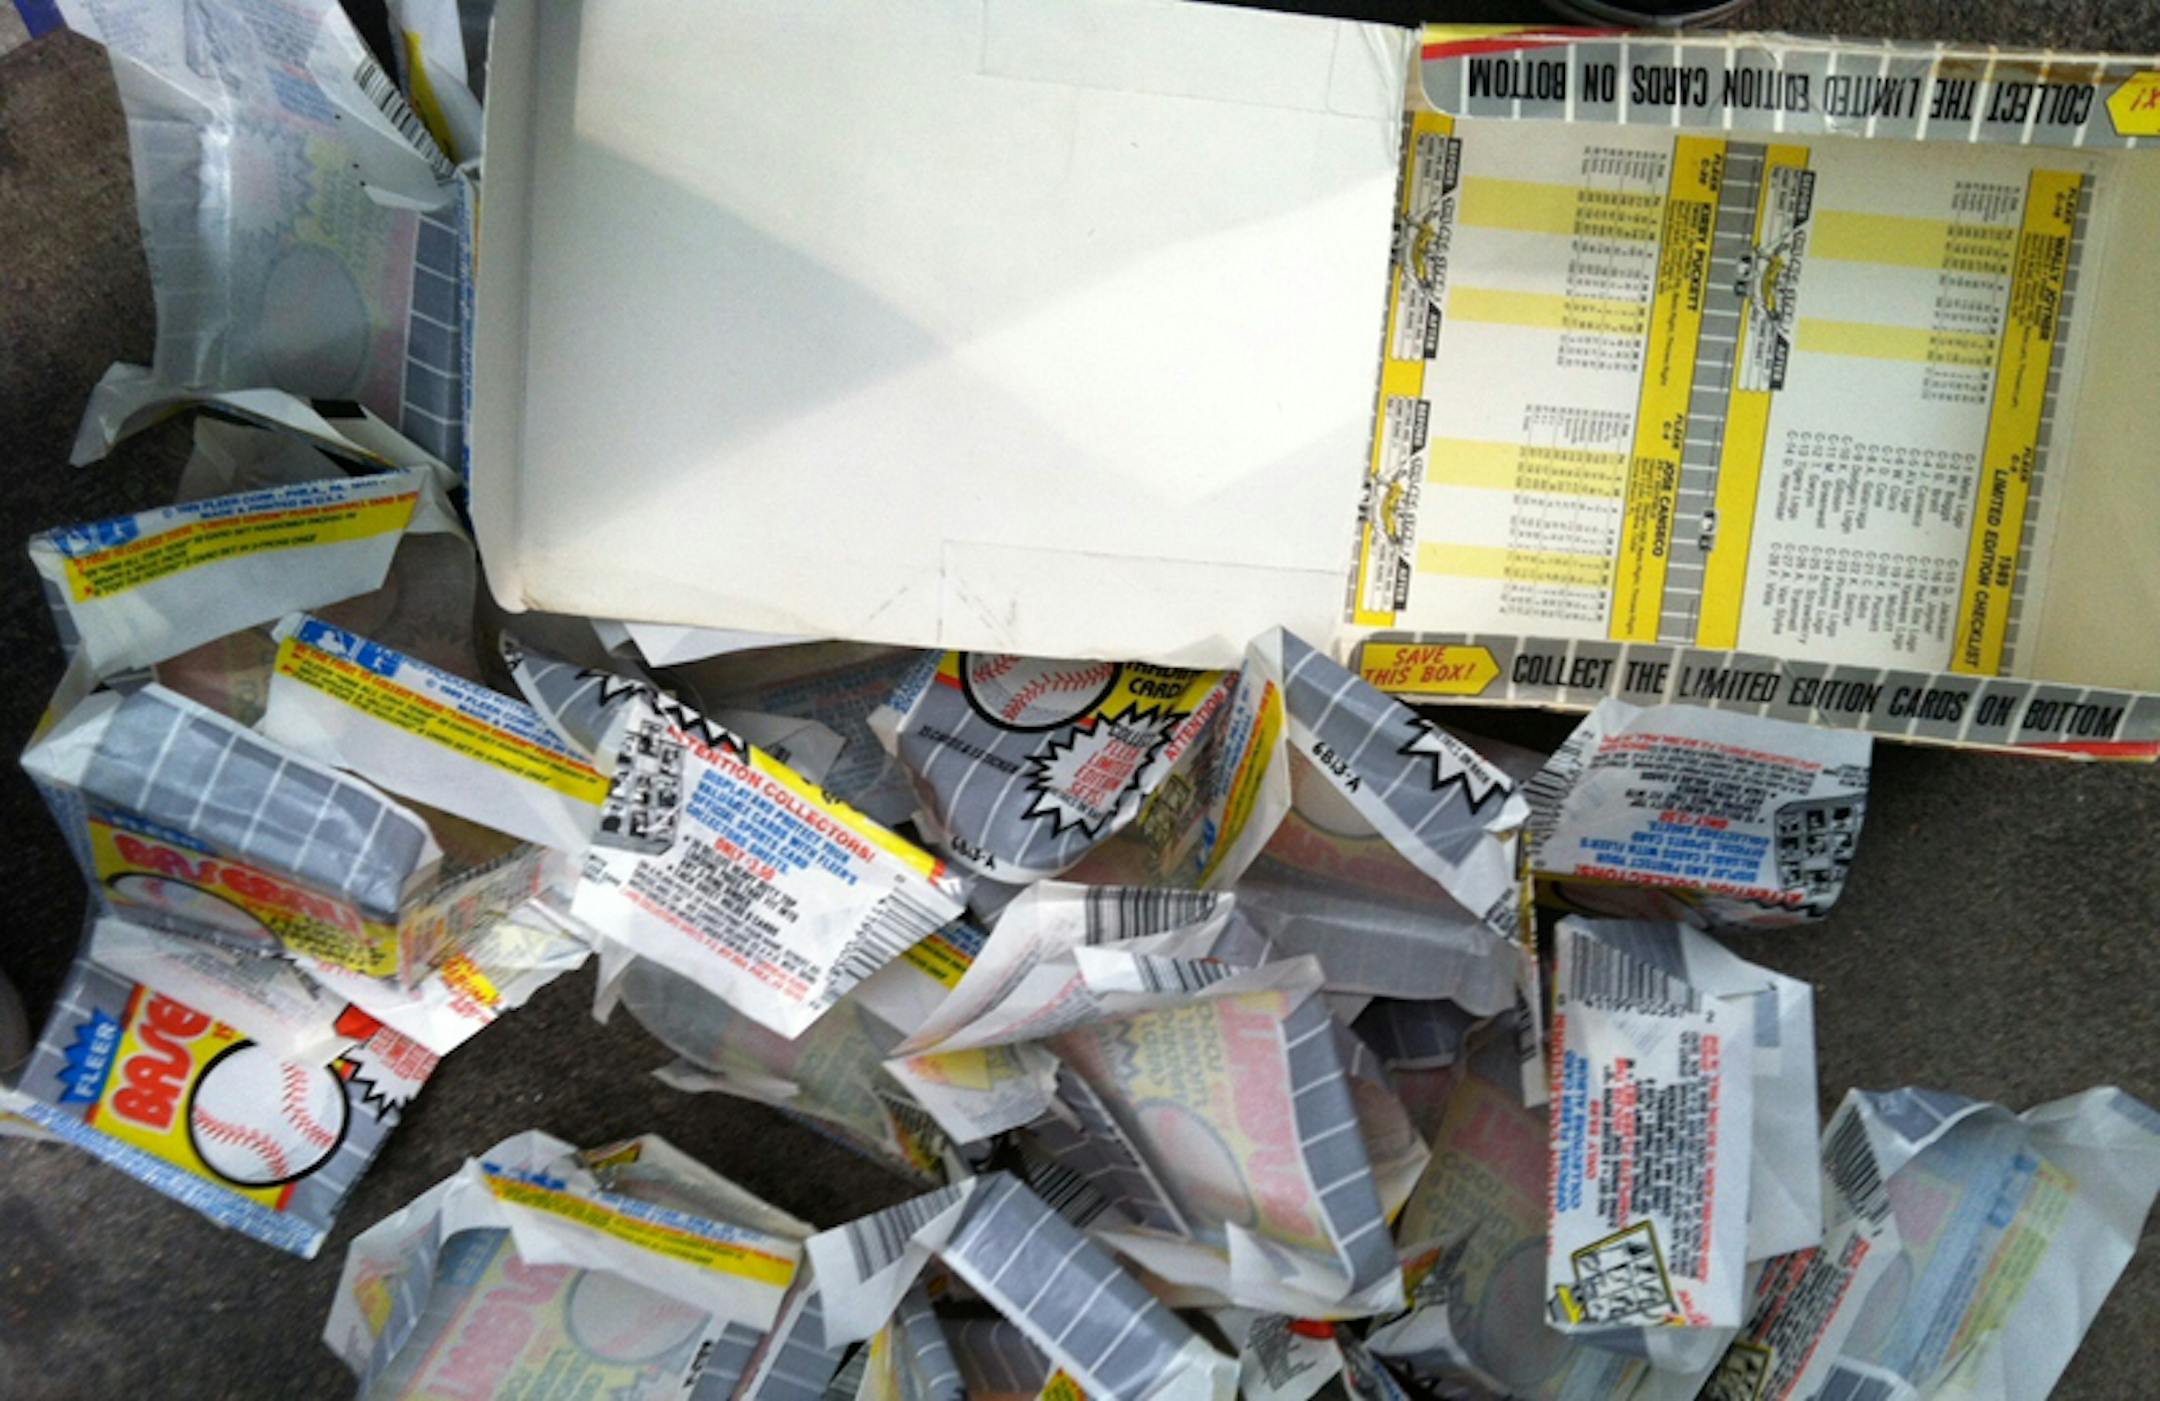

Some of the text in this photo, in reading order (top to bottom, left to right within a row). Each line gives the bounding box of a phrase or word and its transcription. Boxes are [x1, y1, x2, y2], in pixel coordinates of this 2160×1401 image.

[1466, 56, 2094, 126] COLLECT THE LIMITED EDITION CARDS ON BOTTOM
[1685, 202, 1711, 313] KIRBY PUCKETT
[2038, 235, 2066, 342] WALLY JOYNER
[1786, 459, 1806, 520] Tigers Logo
[1802, 473, 1819, 508] Gwynn
[1815, 480, 1832, 530] Greenwell
[1831, 477, 1846, 513] Gibson
[1839, 463, 1862, 534] Dodgers Logo
[1873, 481, 1887, 508] Cone
[1898, 487, 1913, 514] Logo
[1911, 484, 1927, 527] Canseco
[1651, 459, 1675, 558] JOSE CANSECO
[1951, 503, 1966, 529] Logo
[1962, 467, 2008, 668] LIMITED EDITION CHECKLIST
[1994, 555, 2011, 588] 1989
[1762, 581, 1775, 606] Viola
[1776, 584, 1788, 605] Van
[1817, 573, 1831, 608] Astros
[1830, 575, 1845, 610] Pirates
[1856, 593, 1869, 619] Sabo
[1896, 582, 1911, 624] Yankees
[1913, 584, 1926, 604] Red
[1769, 606, 1785, 635] Slyke
[1786, 586, 1802, 632] Trammell
[1795, 587, 1815, 645] Strawberry
[1810, 608, 1825, 634] Logo
[1824, 611, 1839, 638] Logo
[1867, 594, 1883, 633] Puckett
[1881, 592, 1897, 633] McGriff
[1910, 605, 1922, 625] Sox
[1921, 601, 1936, 634] Joyner
[1935, 601, 1950, 642] Jackson
[1890, 624, 1905, 651] Logo
[1904, 627, 1918, 653] Logo
[1363, 659, 1476, 687] THIS BOX!
[1392, 646, 1446, 669] SAVE
[464, 693, 502, 716] FLEER
[1511, 653, 2124, 740] COLLECT THE LIMITED EDITION CARDS ON BOTTOM
[1161, 682, 1225, 767] ATTENTION
[1074, 766, 1125, 794] EDITION
[1086, 750, 1139, 777] LIMITED
[661, 718, 764, 793] ATTENTION
[758, 778, 881, 865] COLLECTORS!
[683, 801, 749, 849] COLLECTORS
[702, 766, 852, 864] DISPLAY AND PROTECT YOUR
[696, 778, 859, 888] VALUABLE CARDS WITH FLEER'S
[713, 835, 747, 864] ONLY
[736, 818, 779, 851] SPORTS
[777, 844, 810, 871] CARD
[1626, 843, 1657, 858] WITH
[1629, 830, 1663, 845] CARD
[1666, 835, 1711, 852] SPORTS
[1594, 852, 1756, 884] DISPLAY AND PROTECT YOUR
[1660, 847, 1701, 864] CARDS
[1573, 863, 1803, 904] ATTENTION COLLECTORS!
[76, 1021, 118, 1100] FLEER
[1556, 1047, 1579, 1211] OFFICIAL FLEER CARD
[1569, 1055, 1590, 1208] COLLECTORS ALBUM
[1584, 1137, 1600, 1179] ONLY
